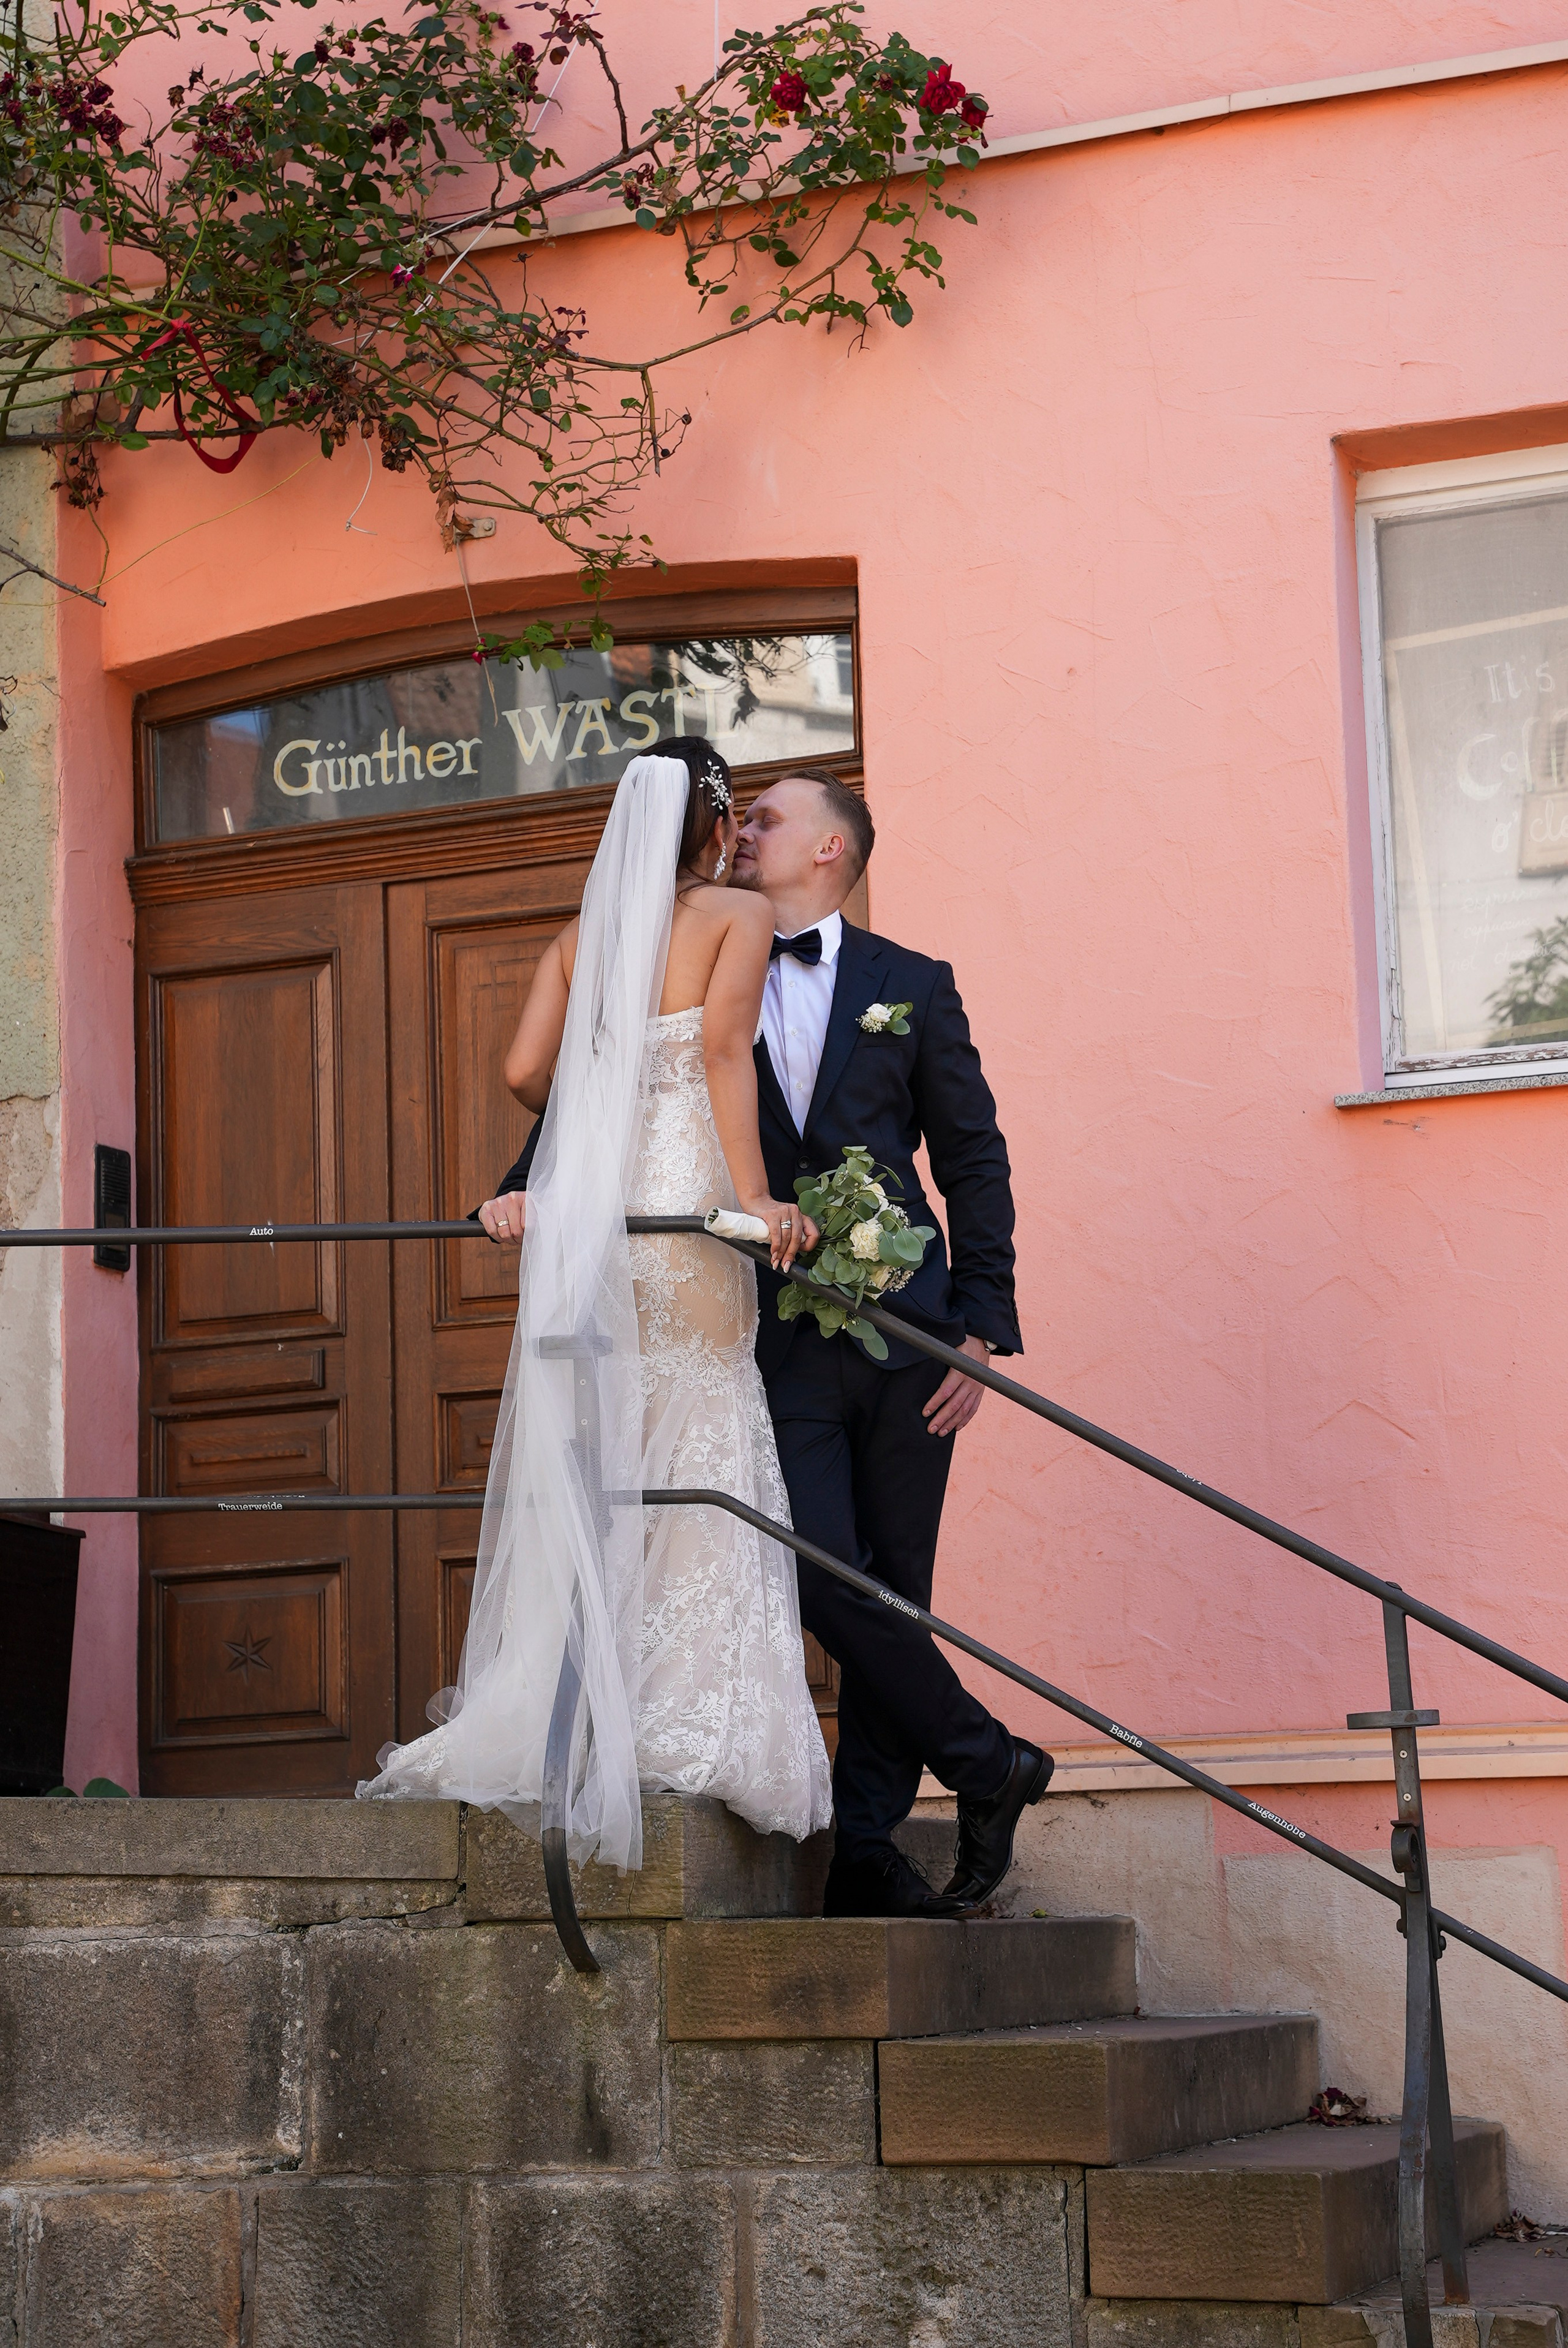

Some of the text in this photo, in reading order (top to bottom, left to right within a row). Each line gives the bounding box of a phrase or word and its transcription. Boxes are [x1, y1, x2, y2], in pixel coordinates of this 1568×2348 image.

[273, 725, 483, 797] Günther
[249, 1227, 274, 1236] Auto
[218, 1501, 283, 1511] Trauerweide
[878, 1590, 919, 1620] idyllisch
